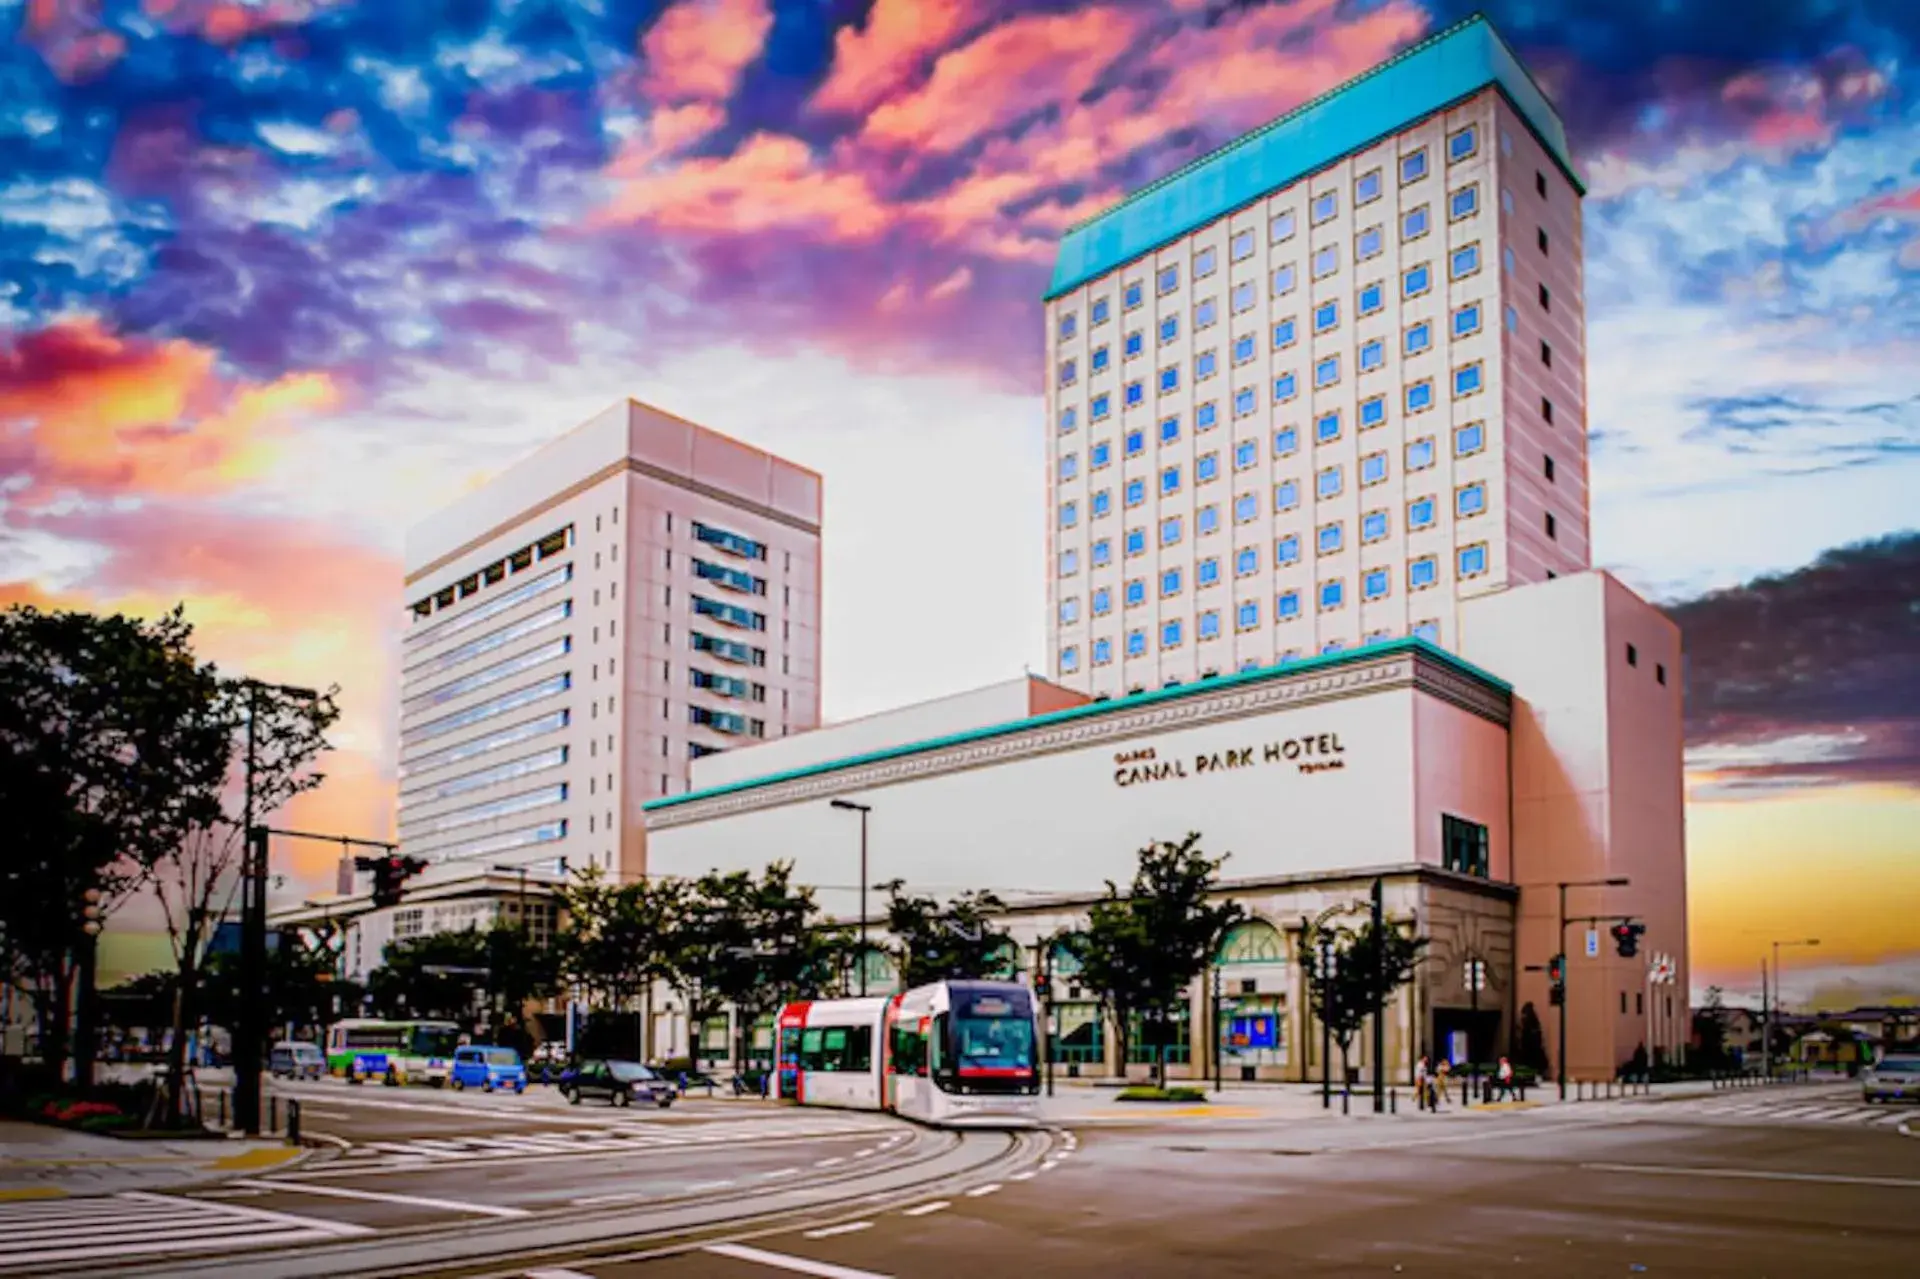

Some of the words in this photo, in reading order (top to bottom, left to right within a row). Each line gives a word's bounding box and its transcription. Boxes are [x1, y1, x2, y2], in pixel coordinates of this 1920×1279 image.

[1114, 761, 1187, 787] CANAL
[1195, 747, 1254, 774] PARK
[1263, 733, 1345, 763] HOTEL
